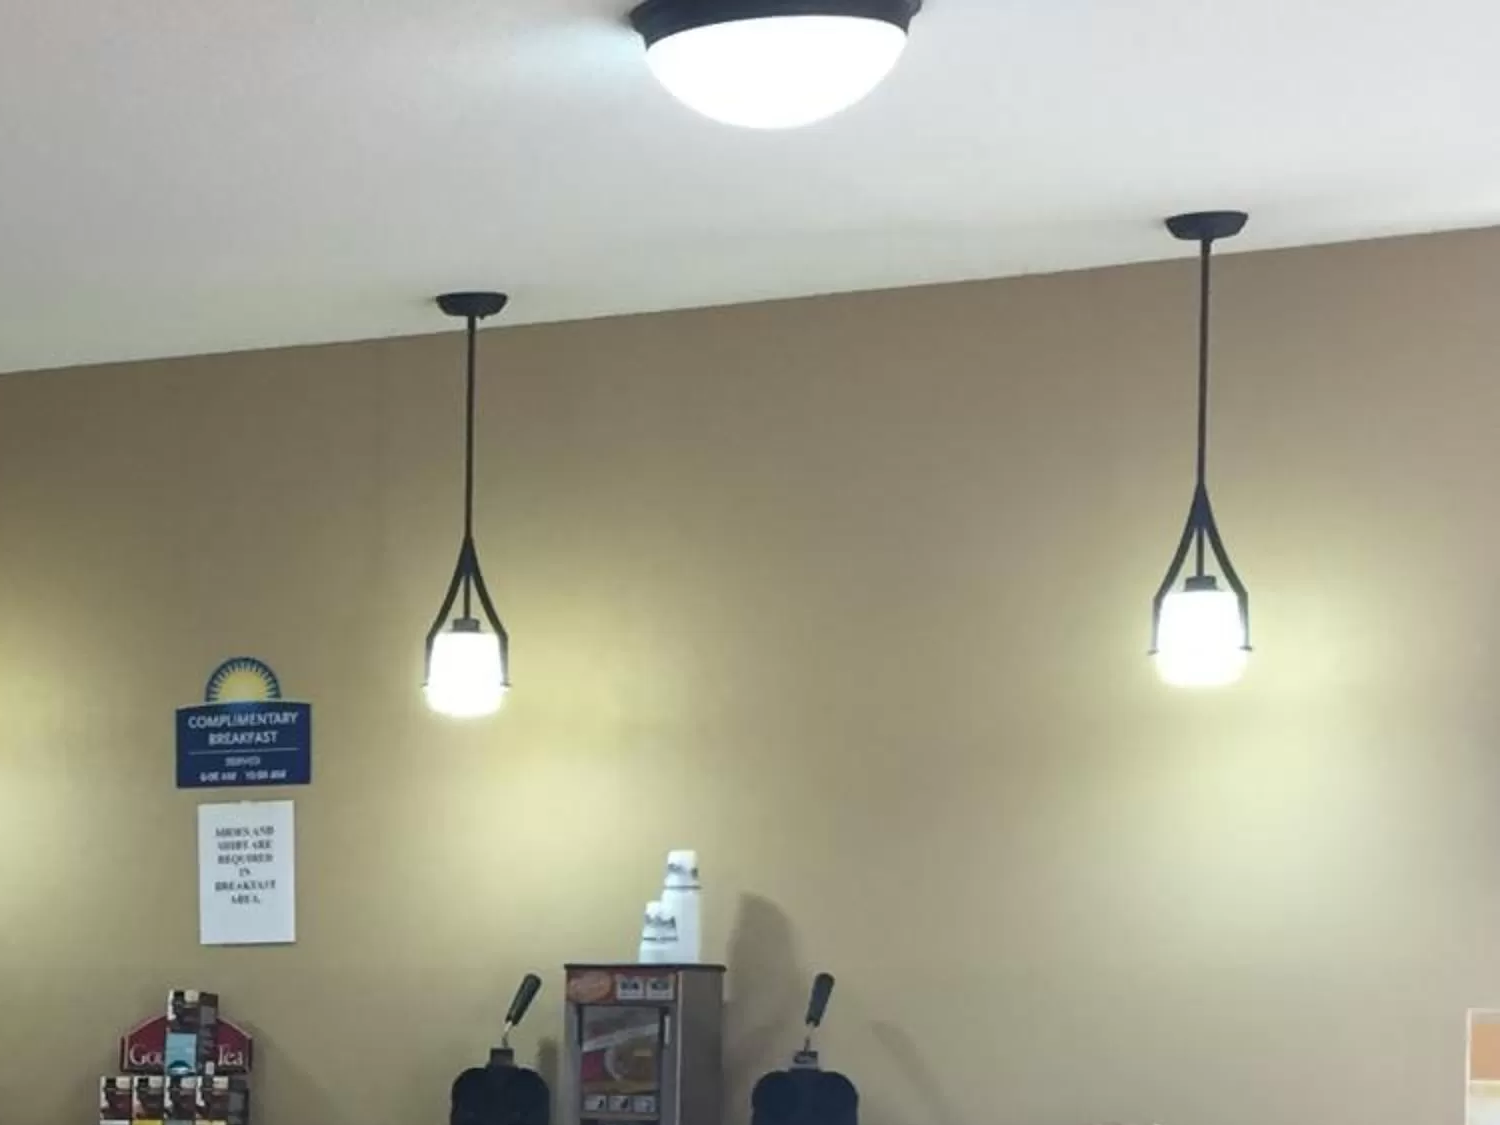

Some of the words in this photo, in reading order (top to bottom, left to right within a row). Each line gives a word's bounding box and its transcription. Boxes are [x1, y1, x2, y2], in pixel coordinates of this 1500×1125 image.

[187, 712, 299, 729] COMPLIMENTARY
[208, 730, 278, 746] BREAKFAST
[216, 1043, 243, 1066] Tea
